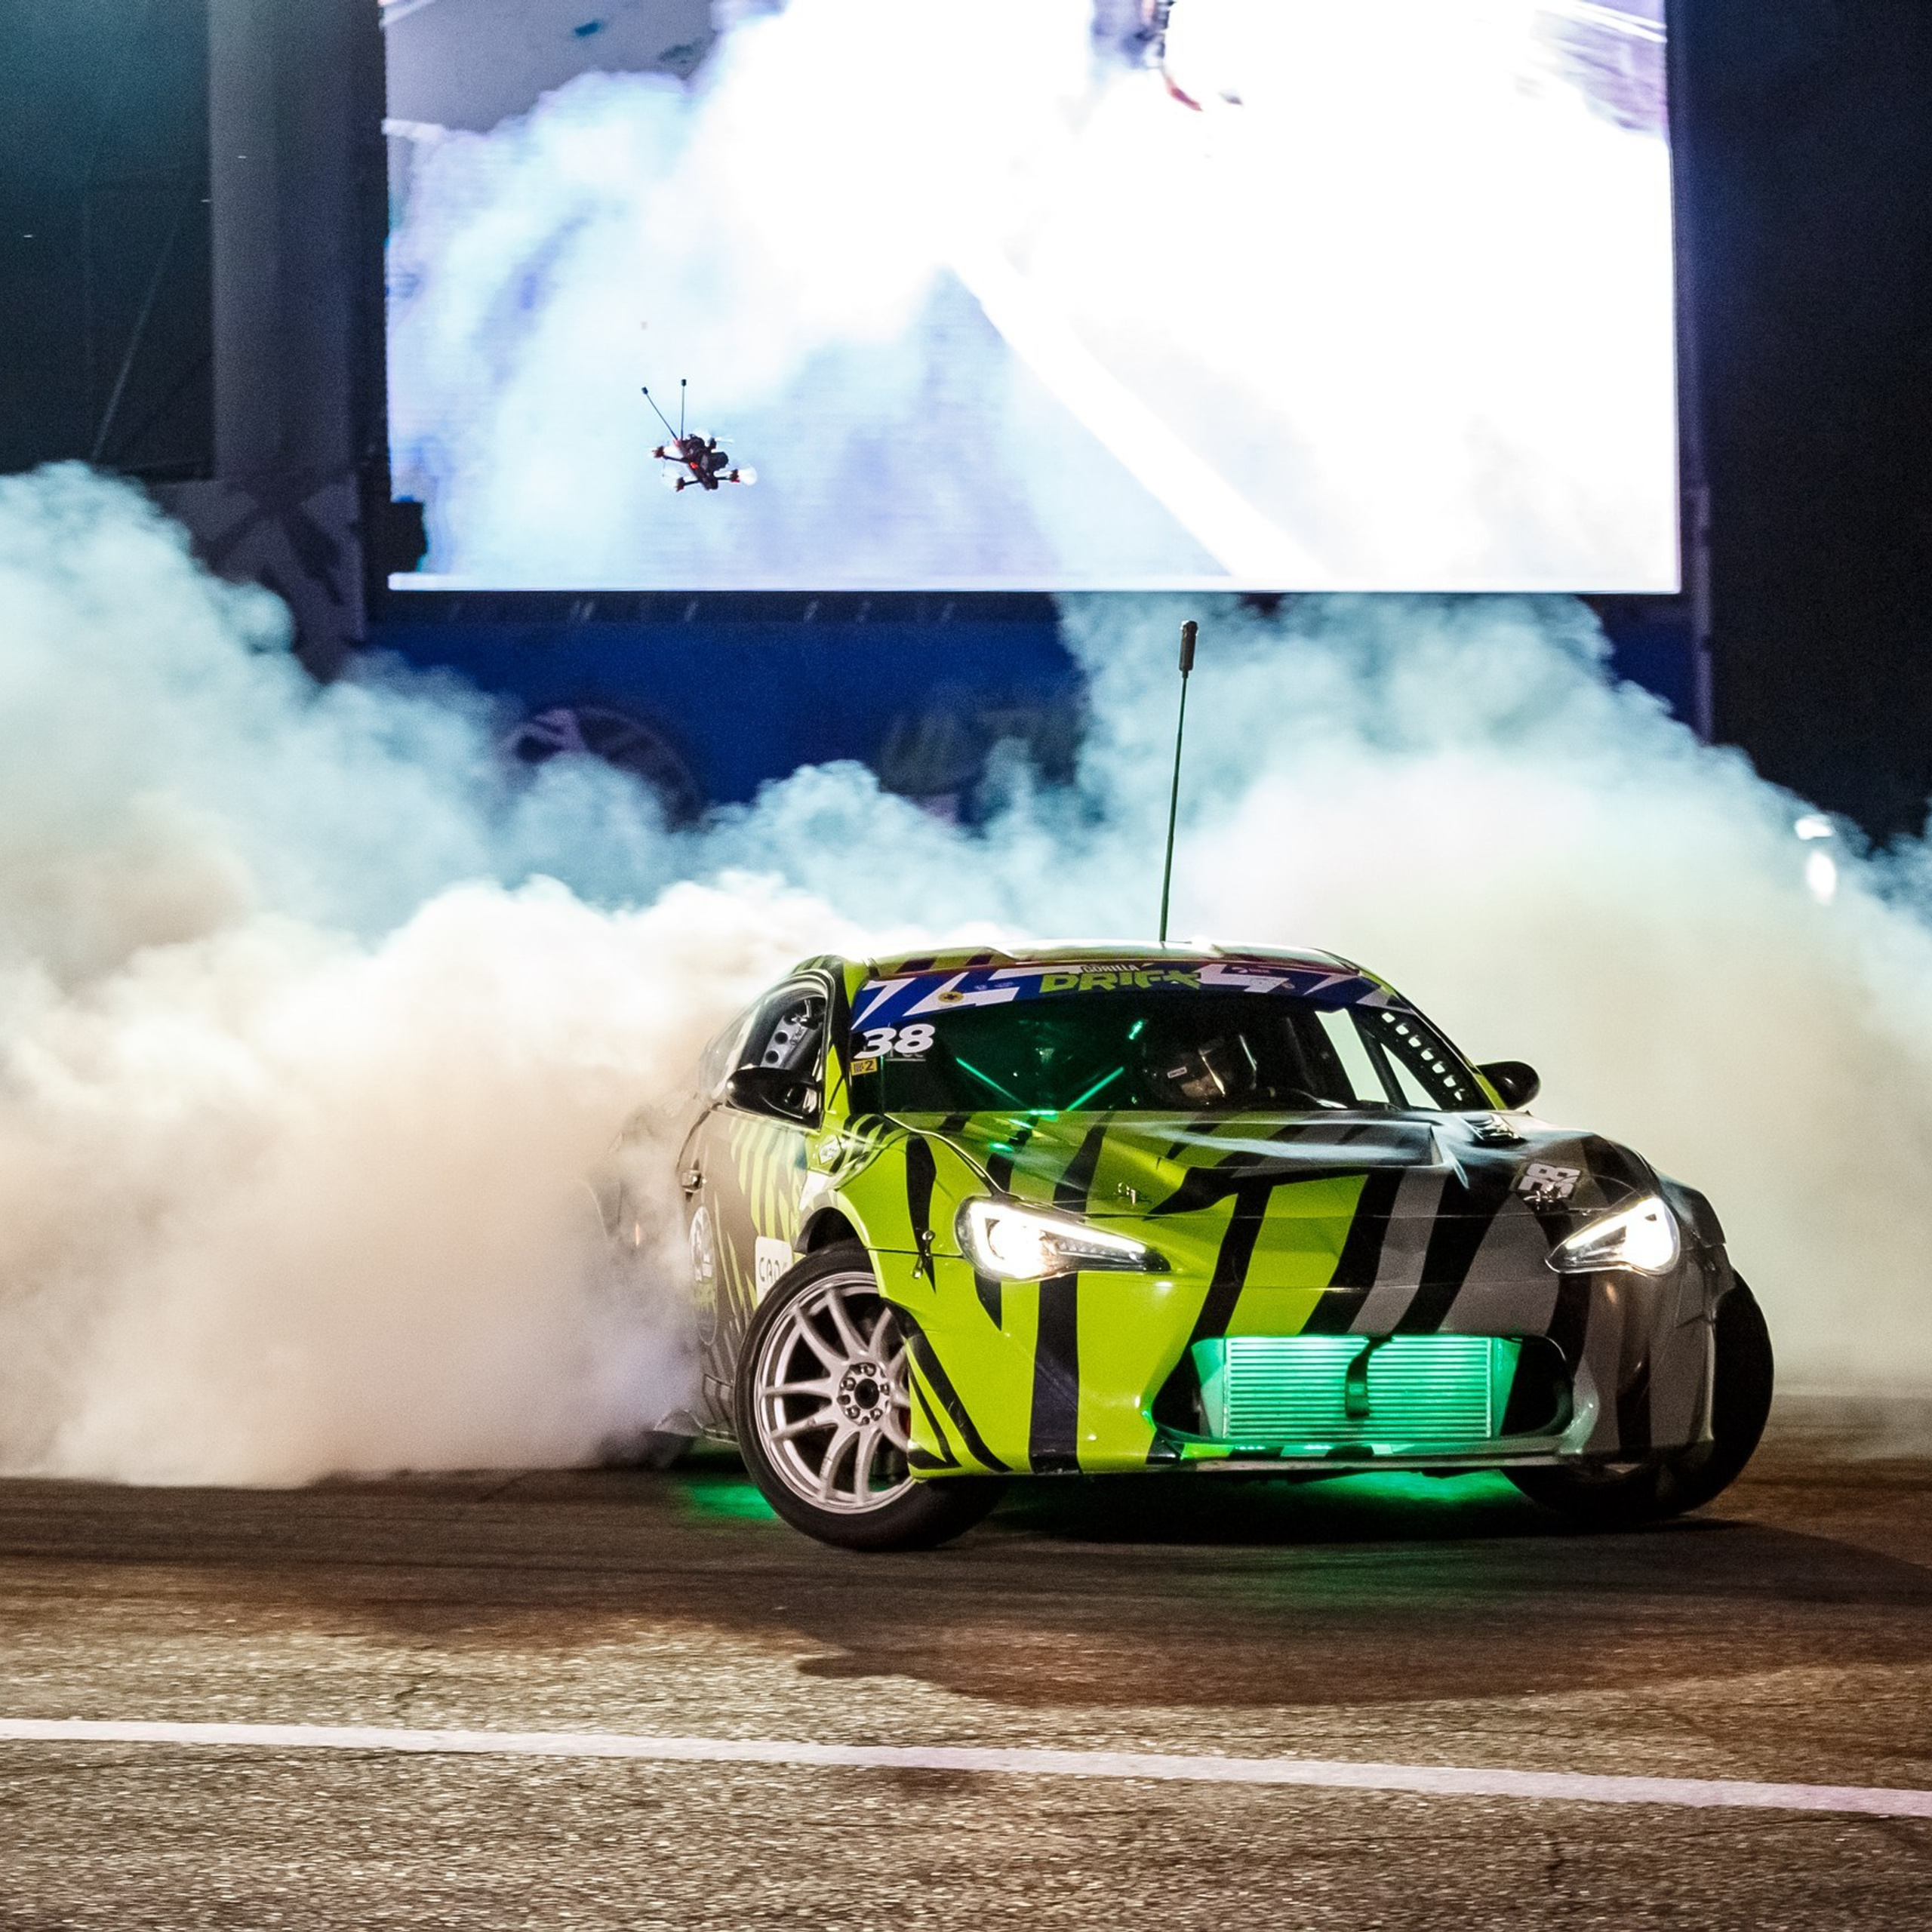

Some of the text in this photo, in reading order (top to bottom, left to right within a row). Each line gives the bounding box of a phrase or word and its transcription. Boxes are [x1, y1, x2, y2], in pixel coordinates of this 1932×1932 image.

[1038, 969, 1201, 994] DRIFT
[1082, 964, 1140, 974] GORILLA
[854, 1023, 935, 1059] 38
